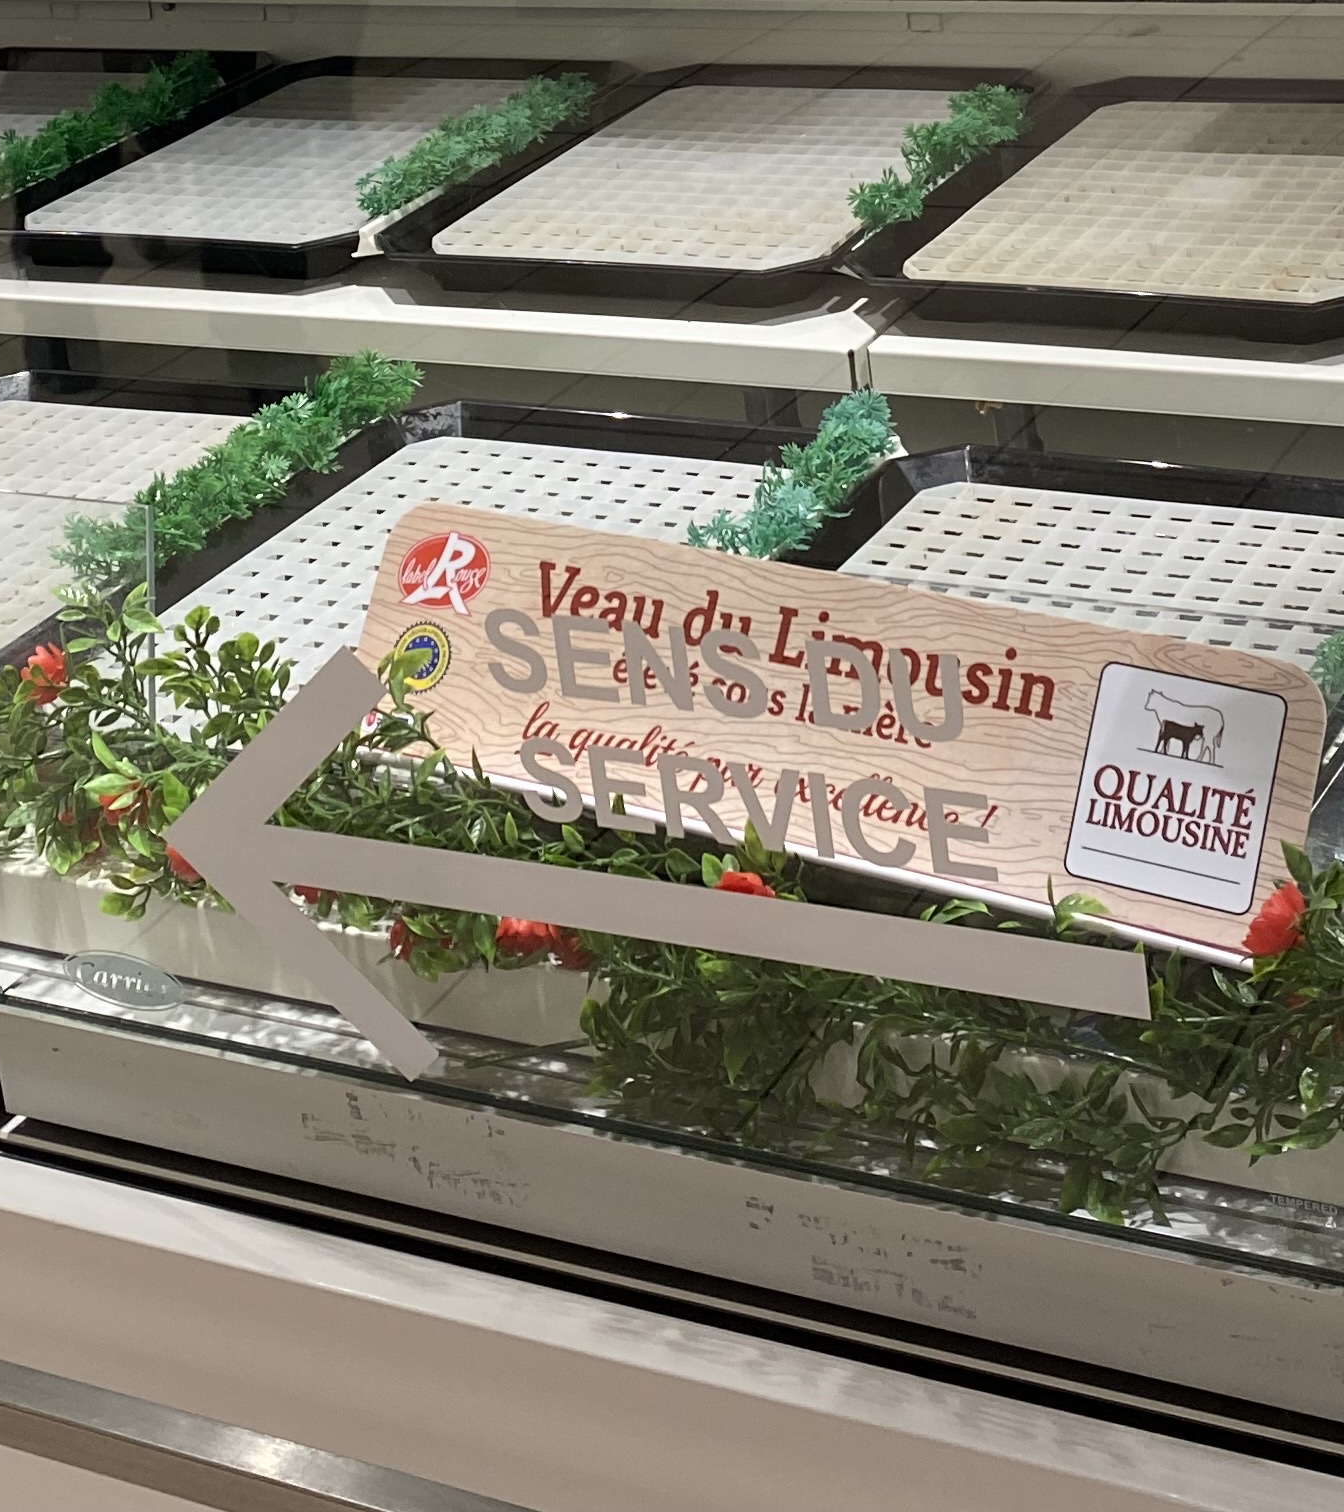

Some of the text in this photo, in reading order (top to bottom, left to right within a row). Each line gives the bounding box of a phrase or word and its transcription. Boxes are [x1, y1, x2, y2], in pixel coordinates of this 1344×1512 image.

[402, 558, 437, 591] label
[539, 560, 664, 639] Veau
[484, 608, 769, 718] SENS
[805, 639, 964, 742] DU
[518, 737, 999, 883] SERVICE
[1084, 800, 1250, 861] LIMOUSINE
[1092, 761, 1257, 831] QUALITÉ
